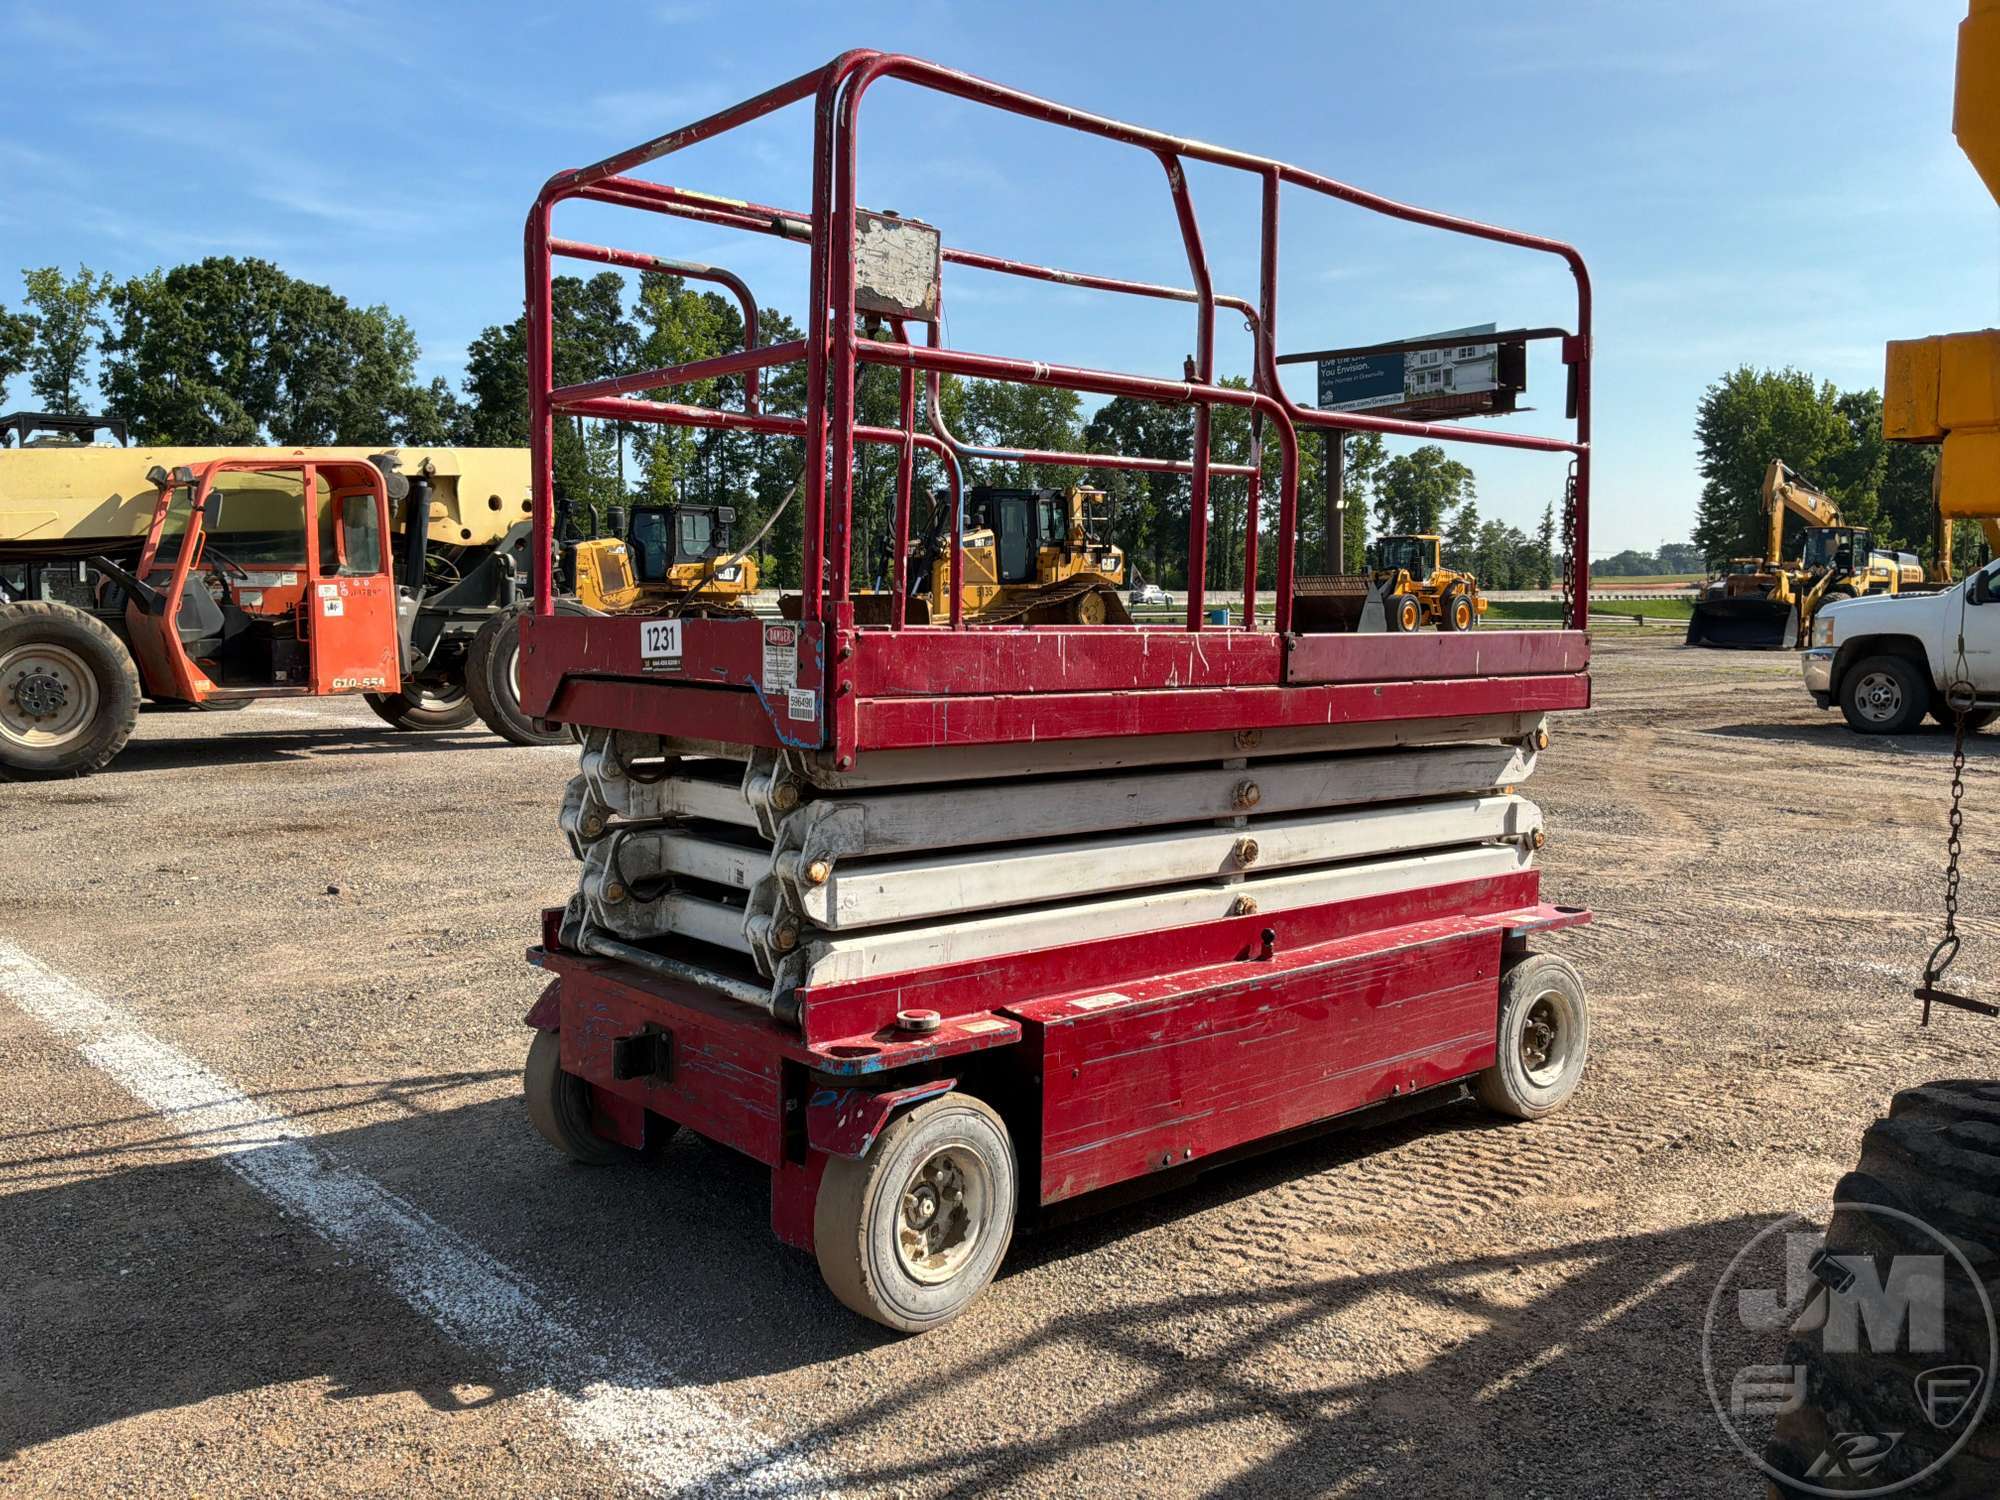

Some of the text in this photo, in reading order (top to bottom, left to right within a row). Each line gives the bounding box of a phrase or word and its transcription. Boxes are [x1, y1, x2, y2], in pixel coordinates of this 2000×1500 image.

[1321, 369, 1336, 377] You
[1101, 558, 1116, 571] CAT
[646, 626, 675, 652] 1231
[769, 628, 792, 643] DANGER
[790, 695, 813, 709] 596490
